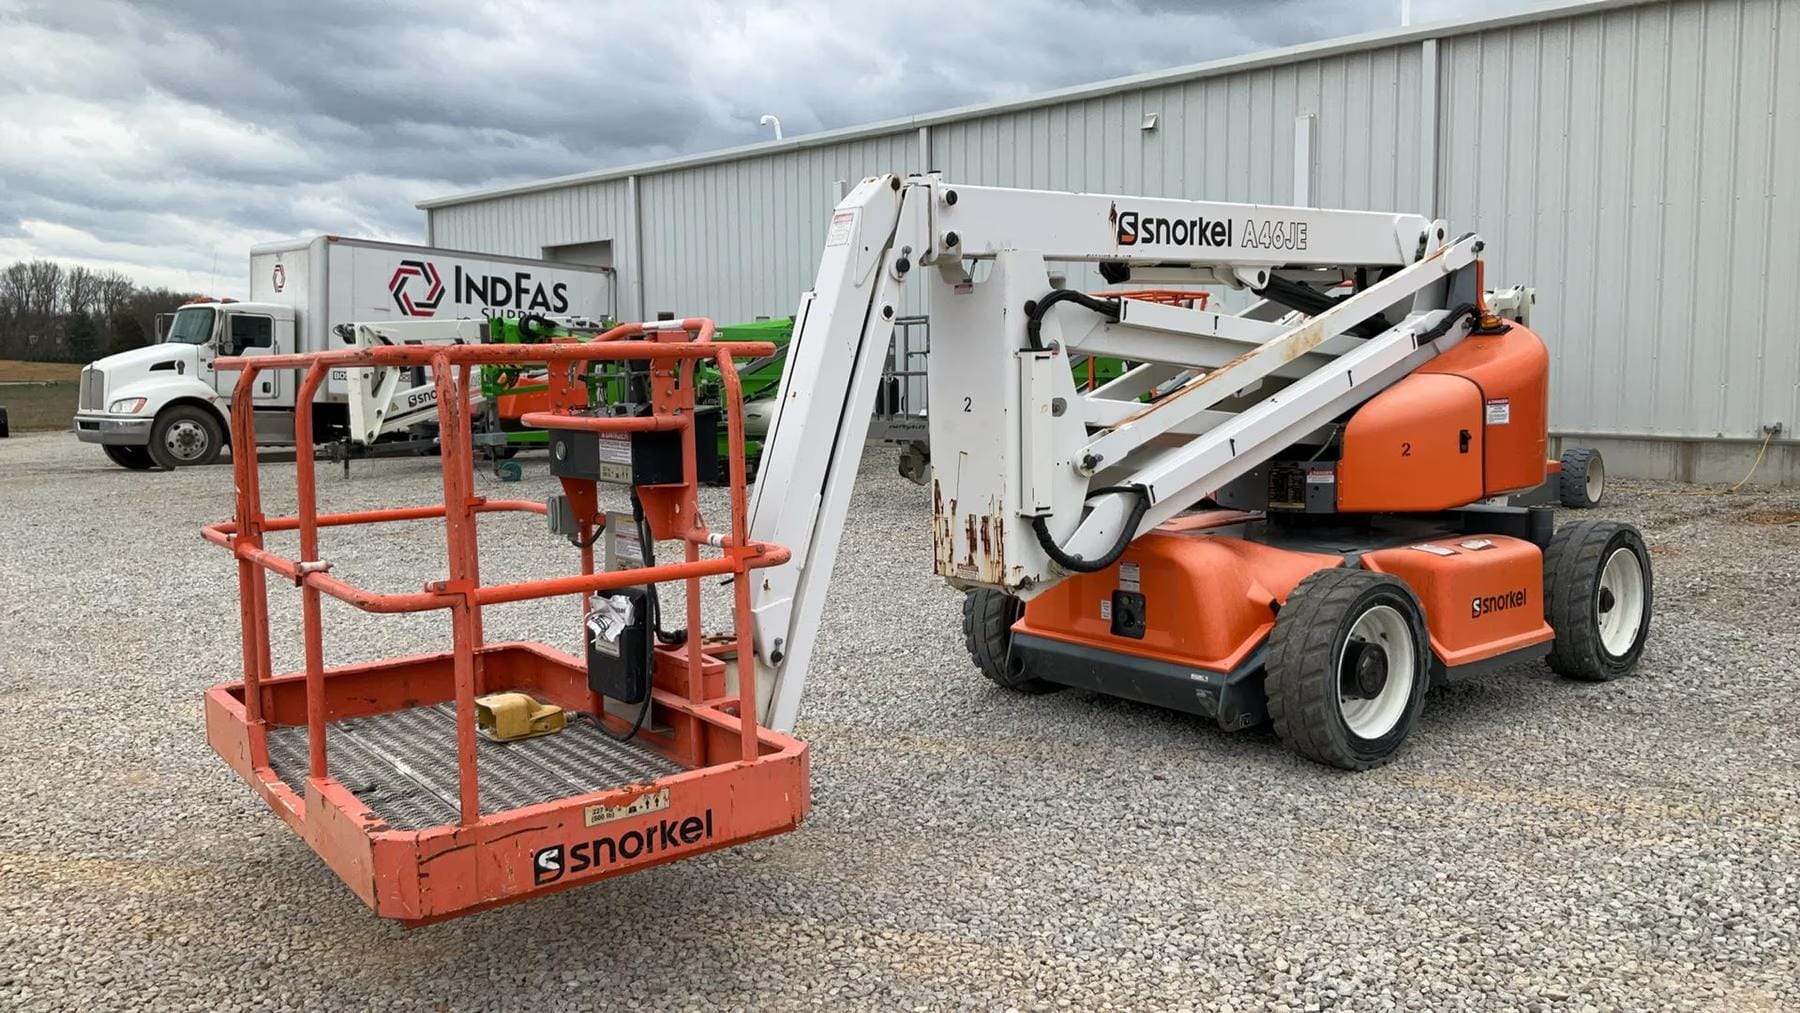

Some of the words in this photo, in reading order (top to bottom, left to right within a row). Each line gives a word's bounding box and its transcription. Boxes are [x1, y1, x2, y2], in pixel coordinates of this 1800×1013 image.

[1141, 216, 1233, 248] snorkel
[1241, 219, 1308, 251] A46JE
[963, 396, 972, 413] 2
[1401, 442, 1411, 457] 2
[1482, 587, 1527, 615] snorkel
[570, 808, 713, 873] snorkel
